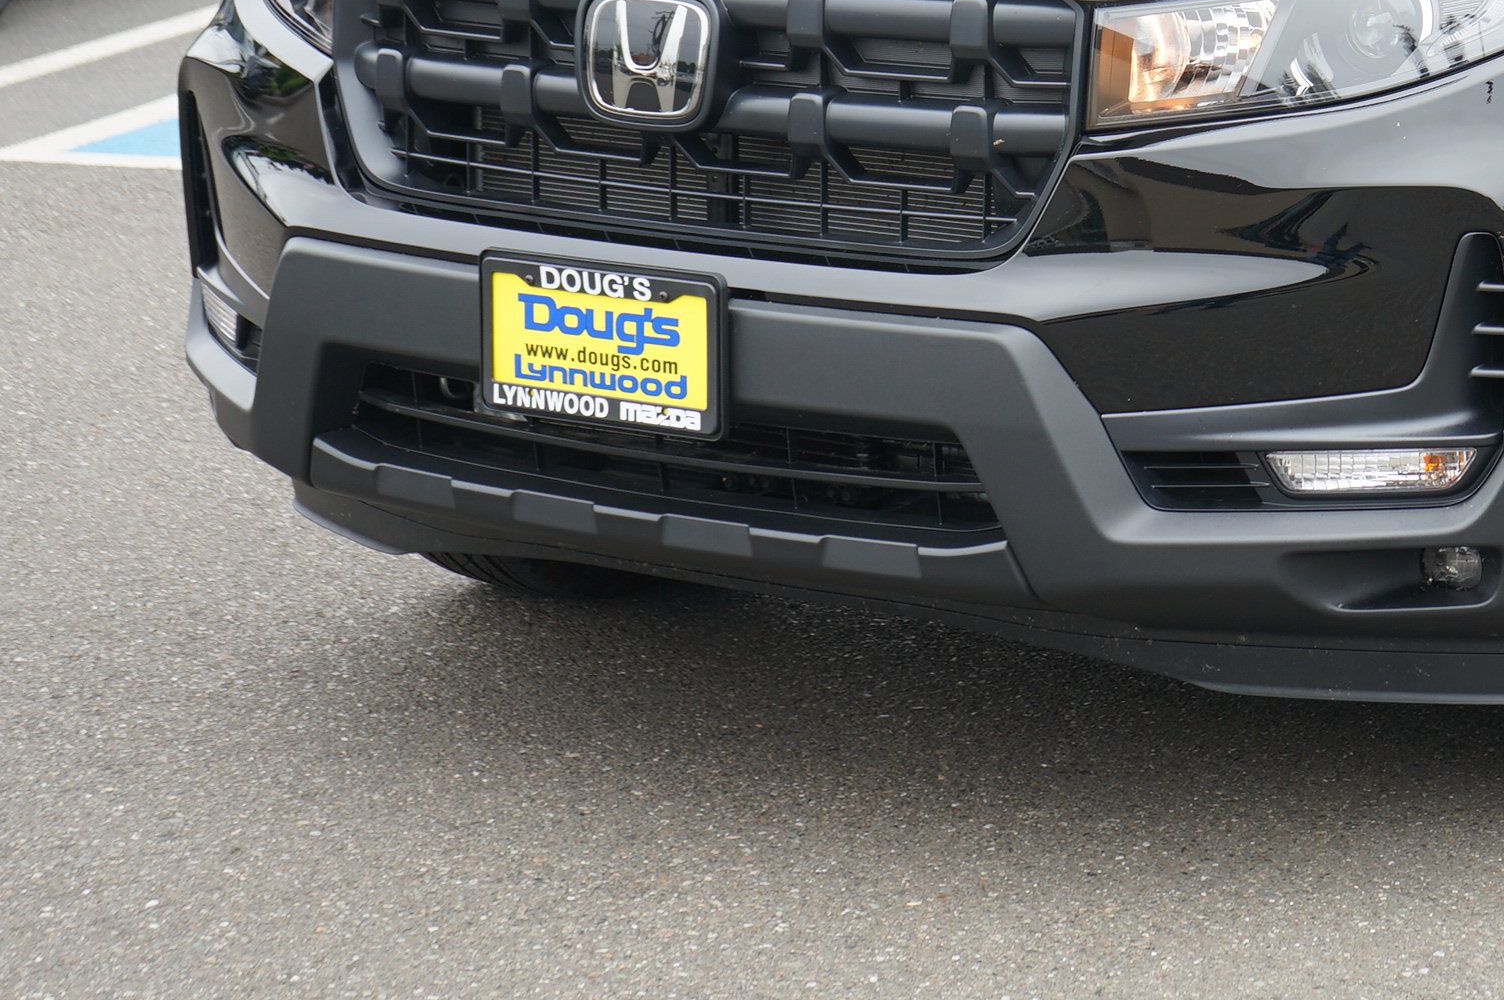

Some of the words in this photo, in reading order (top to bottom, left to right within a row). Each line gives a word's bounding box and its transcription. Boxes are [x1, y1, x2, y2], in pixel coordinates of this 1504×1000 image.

[539, 265, 652, 301] DOUG'S
[514, 353, 688, 399] Lynnwood
[525, 342, 679, 375] www.dougs.com
[493, 383, 609, 419] LYNNWOOD
